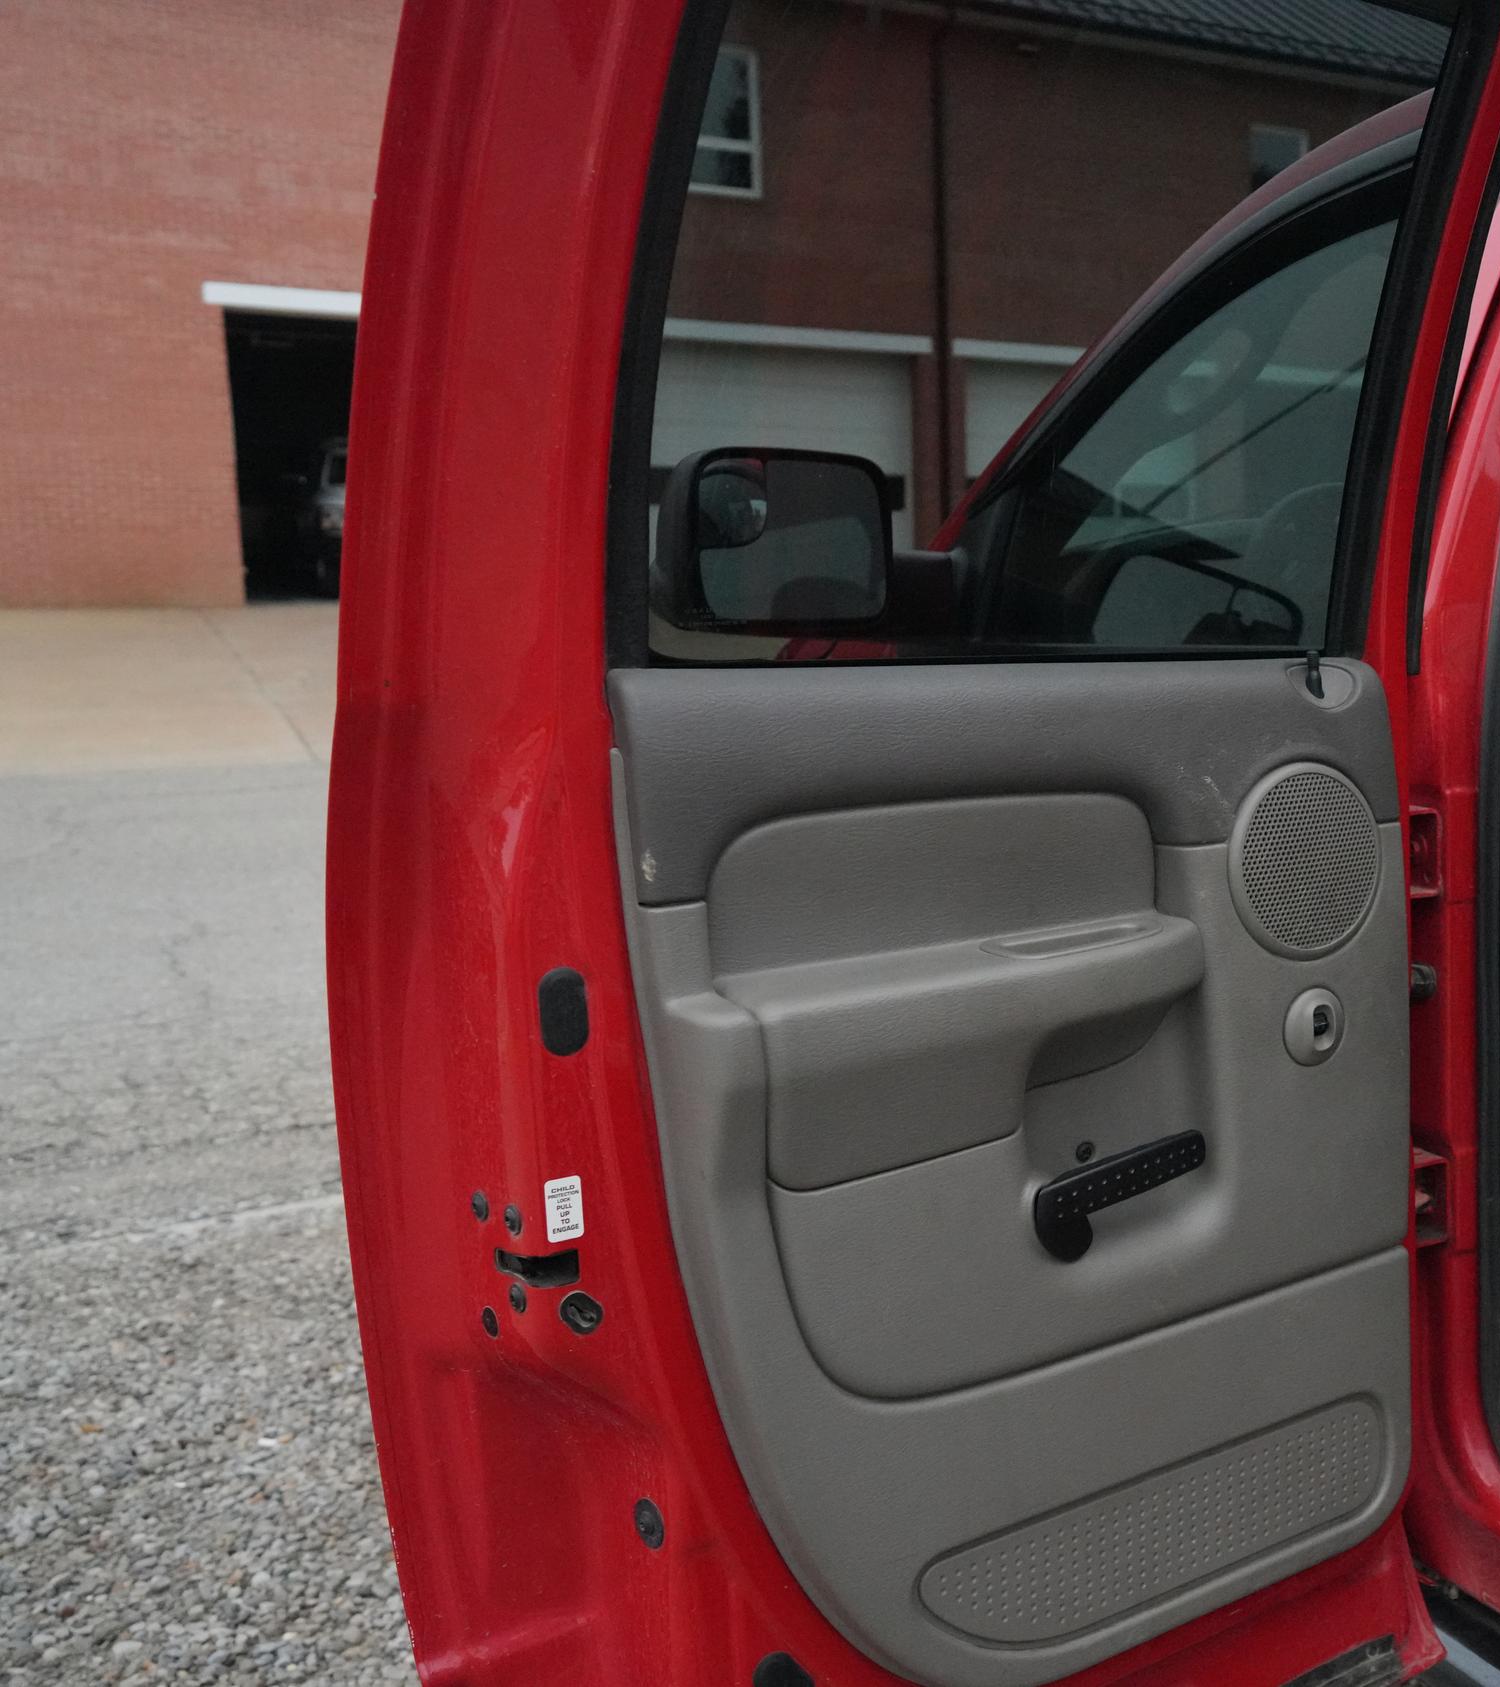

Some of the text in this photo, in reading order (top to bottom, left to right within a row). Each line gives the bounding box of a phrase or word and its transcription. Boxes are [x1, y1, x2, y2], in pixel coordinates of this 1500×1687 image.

[551, 1184, 575, 1194] CHILD
[548, 1190, 579, 1199] PROTECTION
[557, 1203, 572, 1211] PULL
[552, 1224, 579, 1234] ENGAGE
